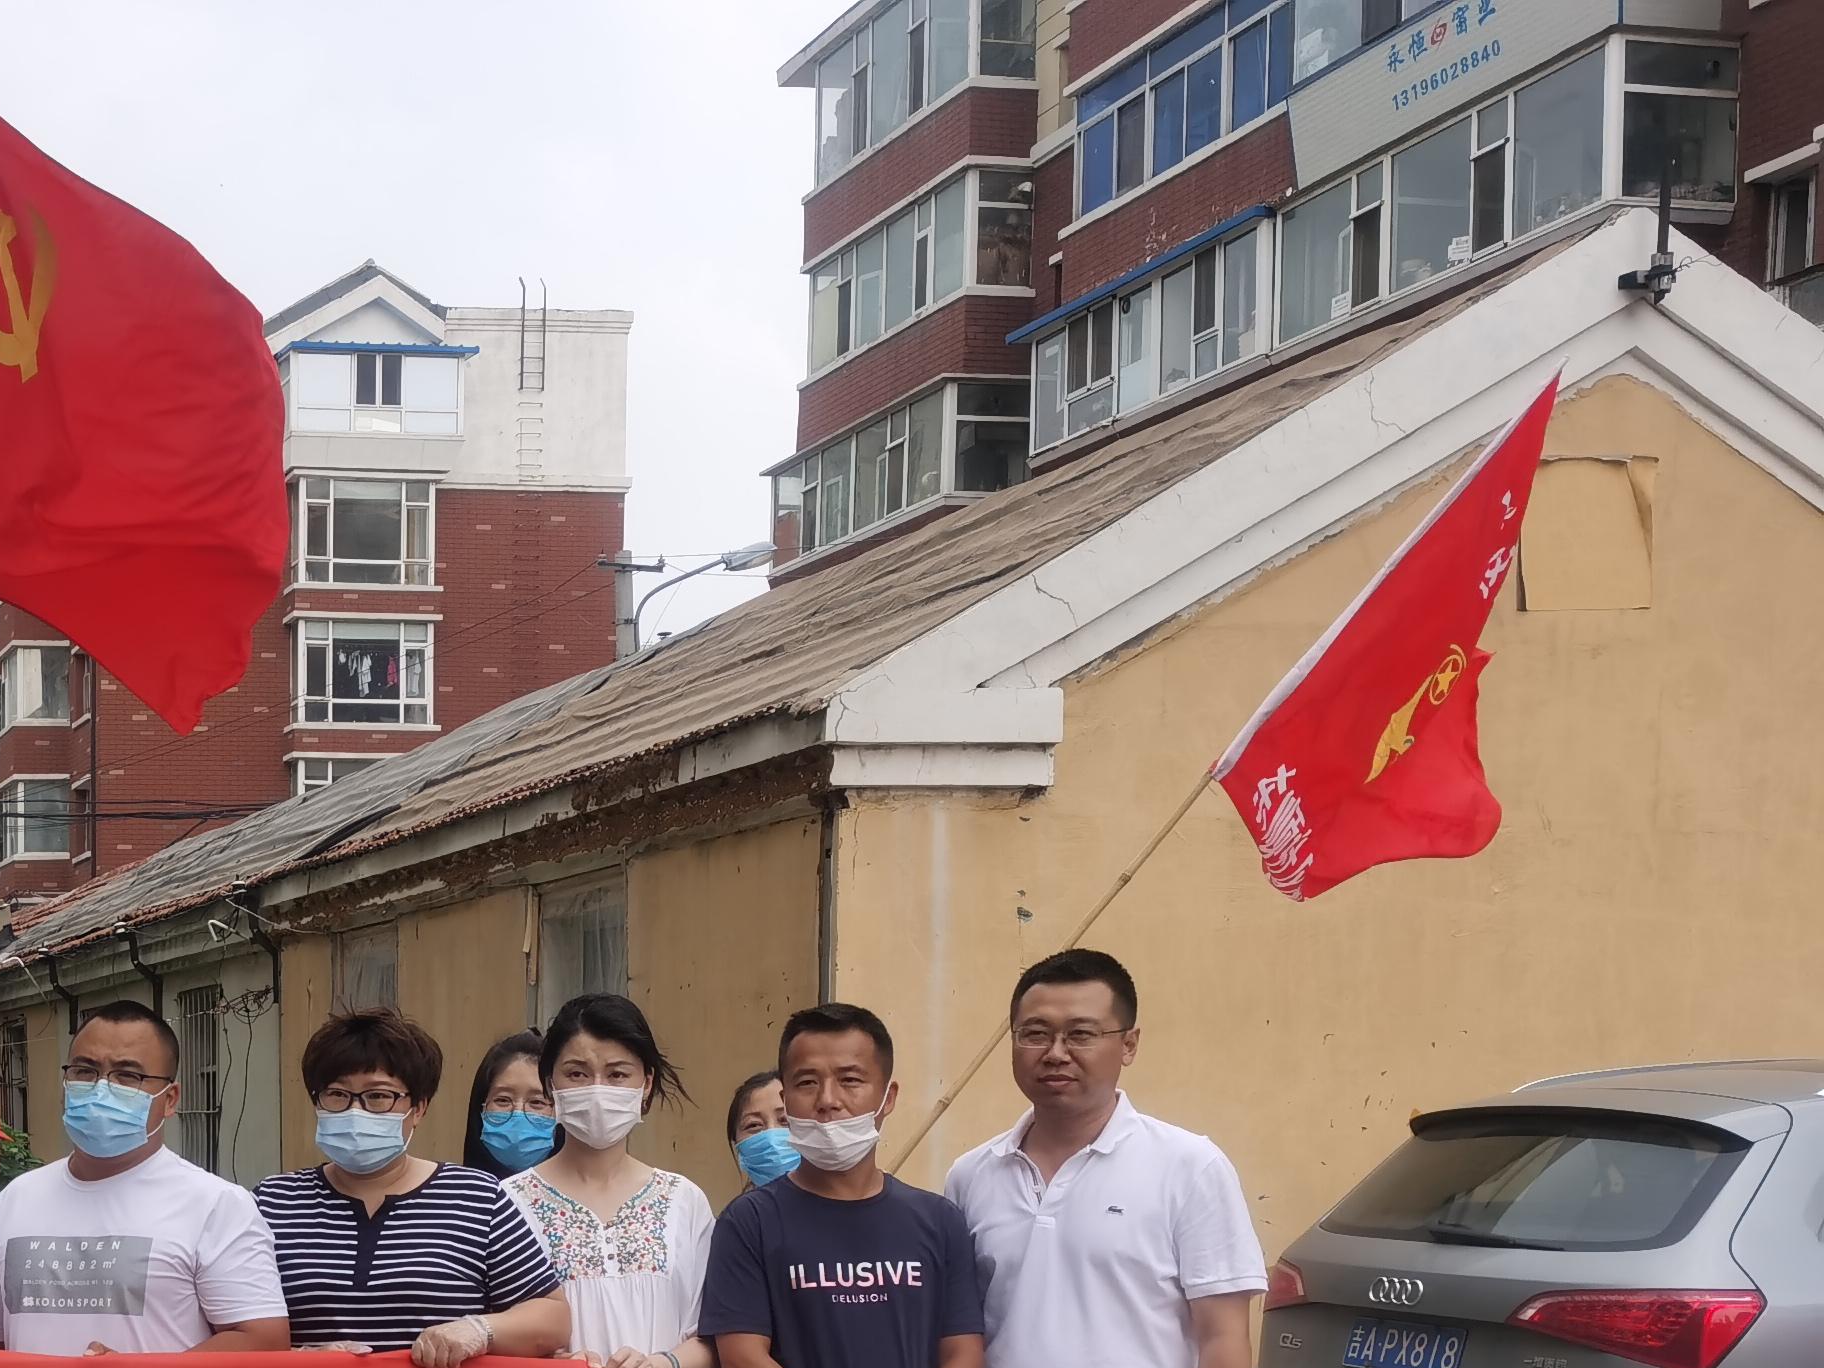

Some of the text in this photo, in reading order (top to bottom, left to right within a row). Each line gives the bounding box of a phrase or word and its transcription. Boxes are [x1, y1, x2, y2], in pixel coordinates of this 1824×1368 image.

[1391, 40, 1501, 110] 13196028840
[30, 1241, 121, 1252] WALDEN
[789, 1261, 923, 1290] ILLUSIVE
[831, 1293, 888, 1304] DELUSION
